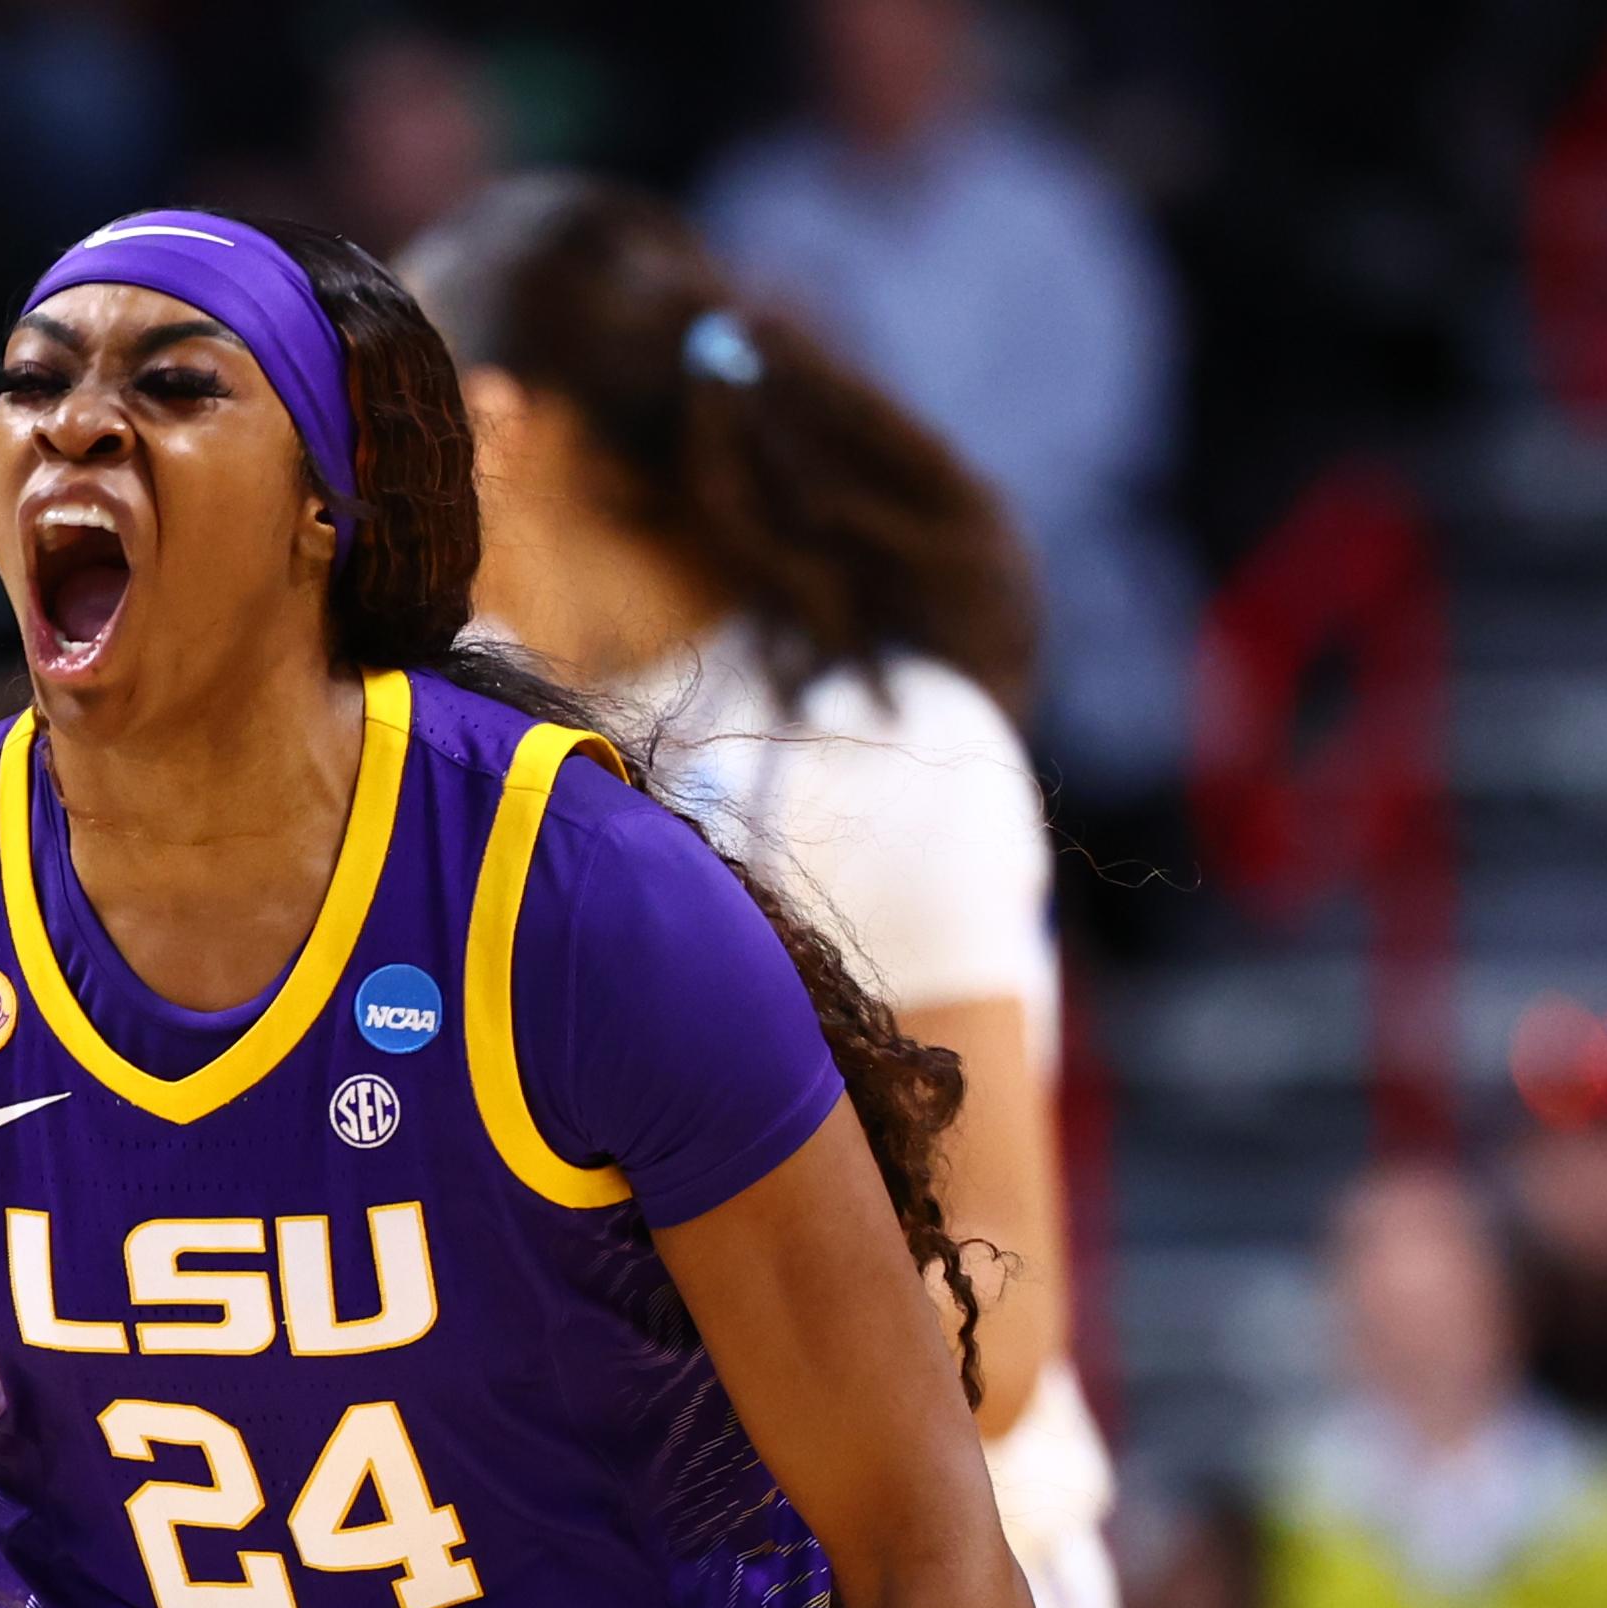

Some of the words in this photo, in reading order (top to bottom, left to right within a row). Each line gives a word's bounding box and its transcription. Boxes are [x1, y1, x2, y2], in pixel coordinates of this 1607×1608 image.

[365, 1004, 436, 1033] NCAA
[337, 1081, 393, 1141] SEC
[6, 1201, 439, 1356] LSU
